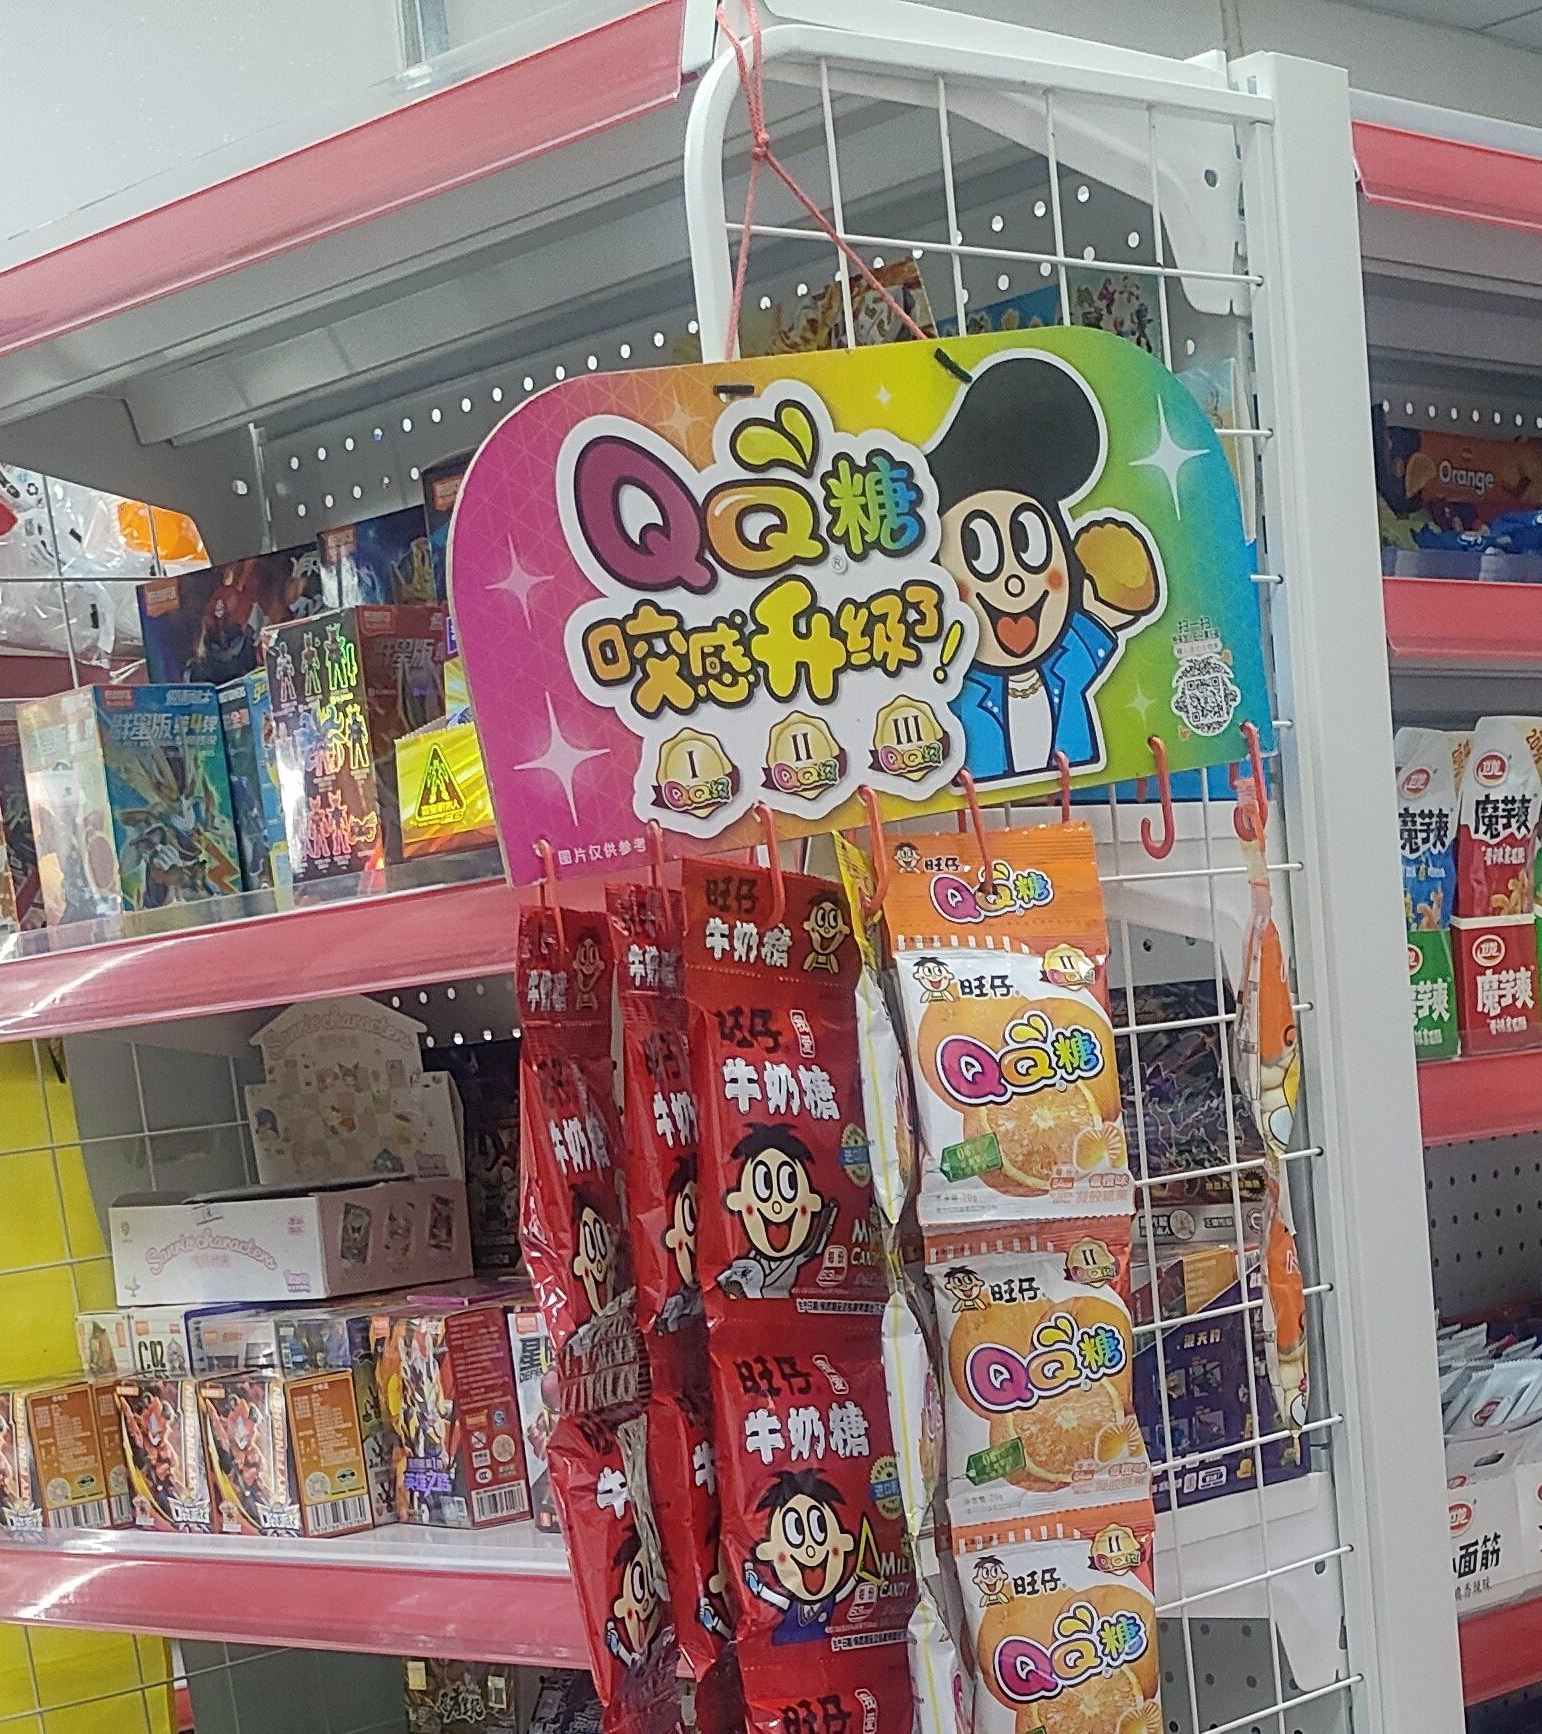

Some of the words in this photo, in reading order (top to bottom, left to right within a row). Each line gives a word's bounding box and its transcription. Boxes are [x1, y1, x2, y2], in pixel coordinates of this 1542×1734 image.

[1439, 463, 1496, 494] Orange
[1473, 793, 1536, 842] 魔芋爽
[557, 836, 647, 865] 图片仅供参考
[958, 972, 1015, 999] 旺仔
[1475, 966, 1536, 1017] 魔芋爽
[722, 1056, 841, 1121] 牛奶糖
[939, 1027, 1104, 1104] QQ糖
[989, 1276, 1041, 1304] 旺仔
[968, 1330, 1126, 1411] QQ糖
[744, 1402, 870, 1466] 牛奶糖
[1013, 1567, 1062, 1598] 旺仔
[995, 1612, 1145, 1701] QQ糖
